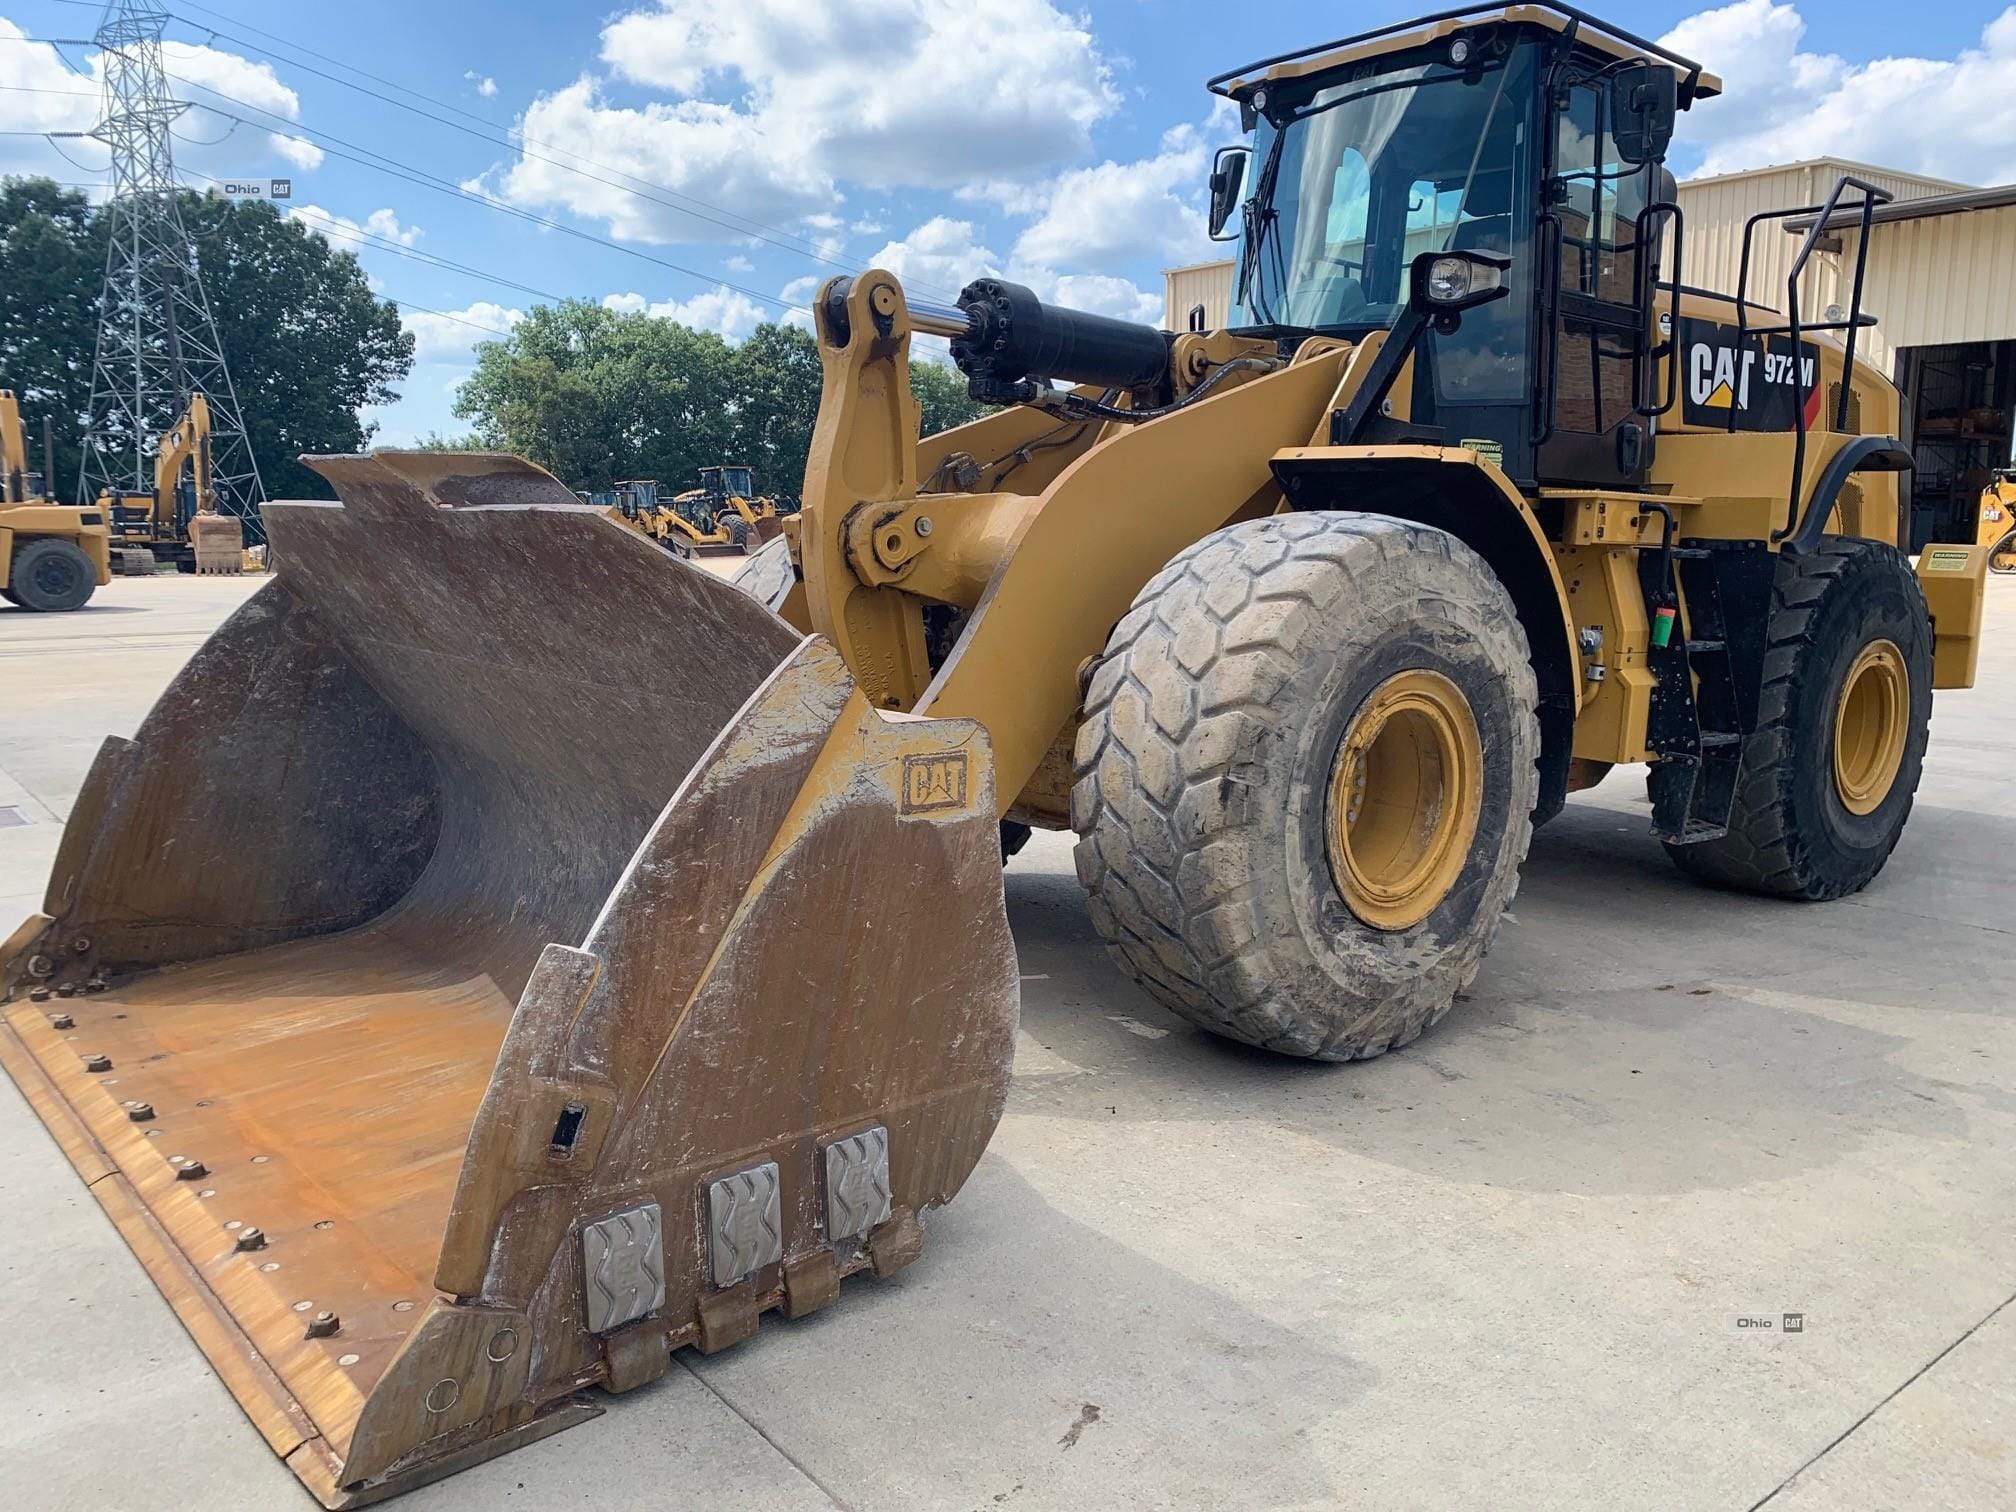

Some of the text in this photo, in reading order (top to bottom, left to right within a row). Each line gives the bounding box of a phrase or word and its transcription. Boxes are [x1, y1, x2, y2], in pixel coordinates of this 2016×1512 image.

[1690, 342, 1814, 410] CAT 972M
[1463, 442, 1501, 453] WARNING
[1983, 510, 2001, 520] CAT
